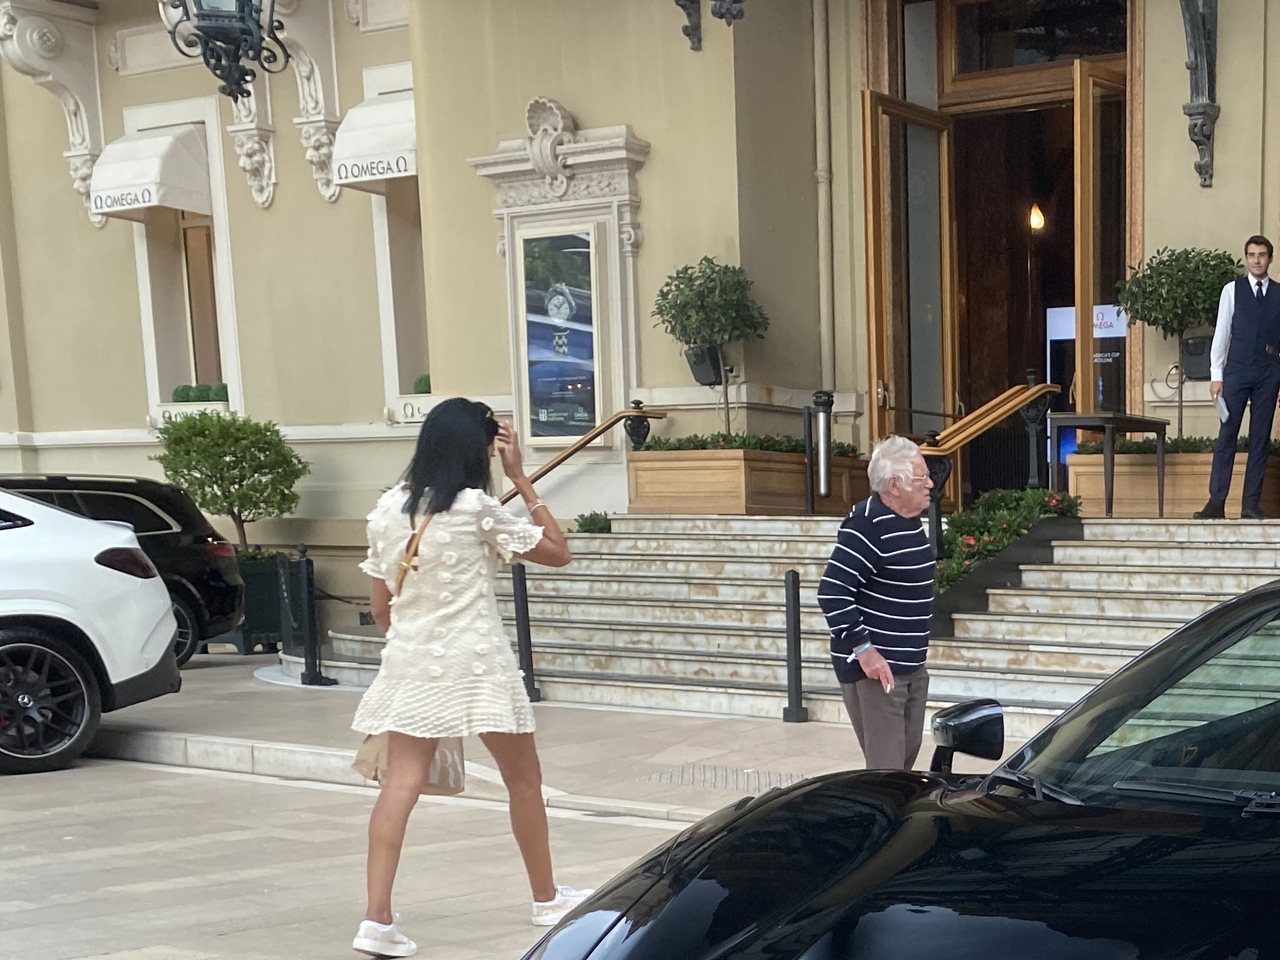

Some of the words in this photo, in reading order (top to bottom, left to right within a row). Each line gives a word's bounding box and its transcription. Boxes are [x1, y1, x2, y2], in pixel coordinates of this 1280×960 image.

[351, 161, 394, 178] OMEGA
[105, 192, 140, 208] OMEGA
[1093, 321, 1114, 329] MEGA
